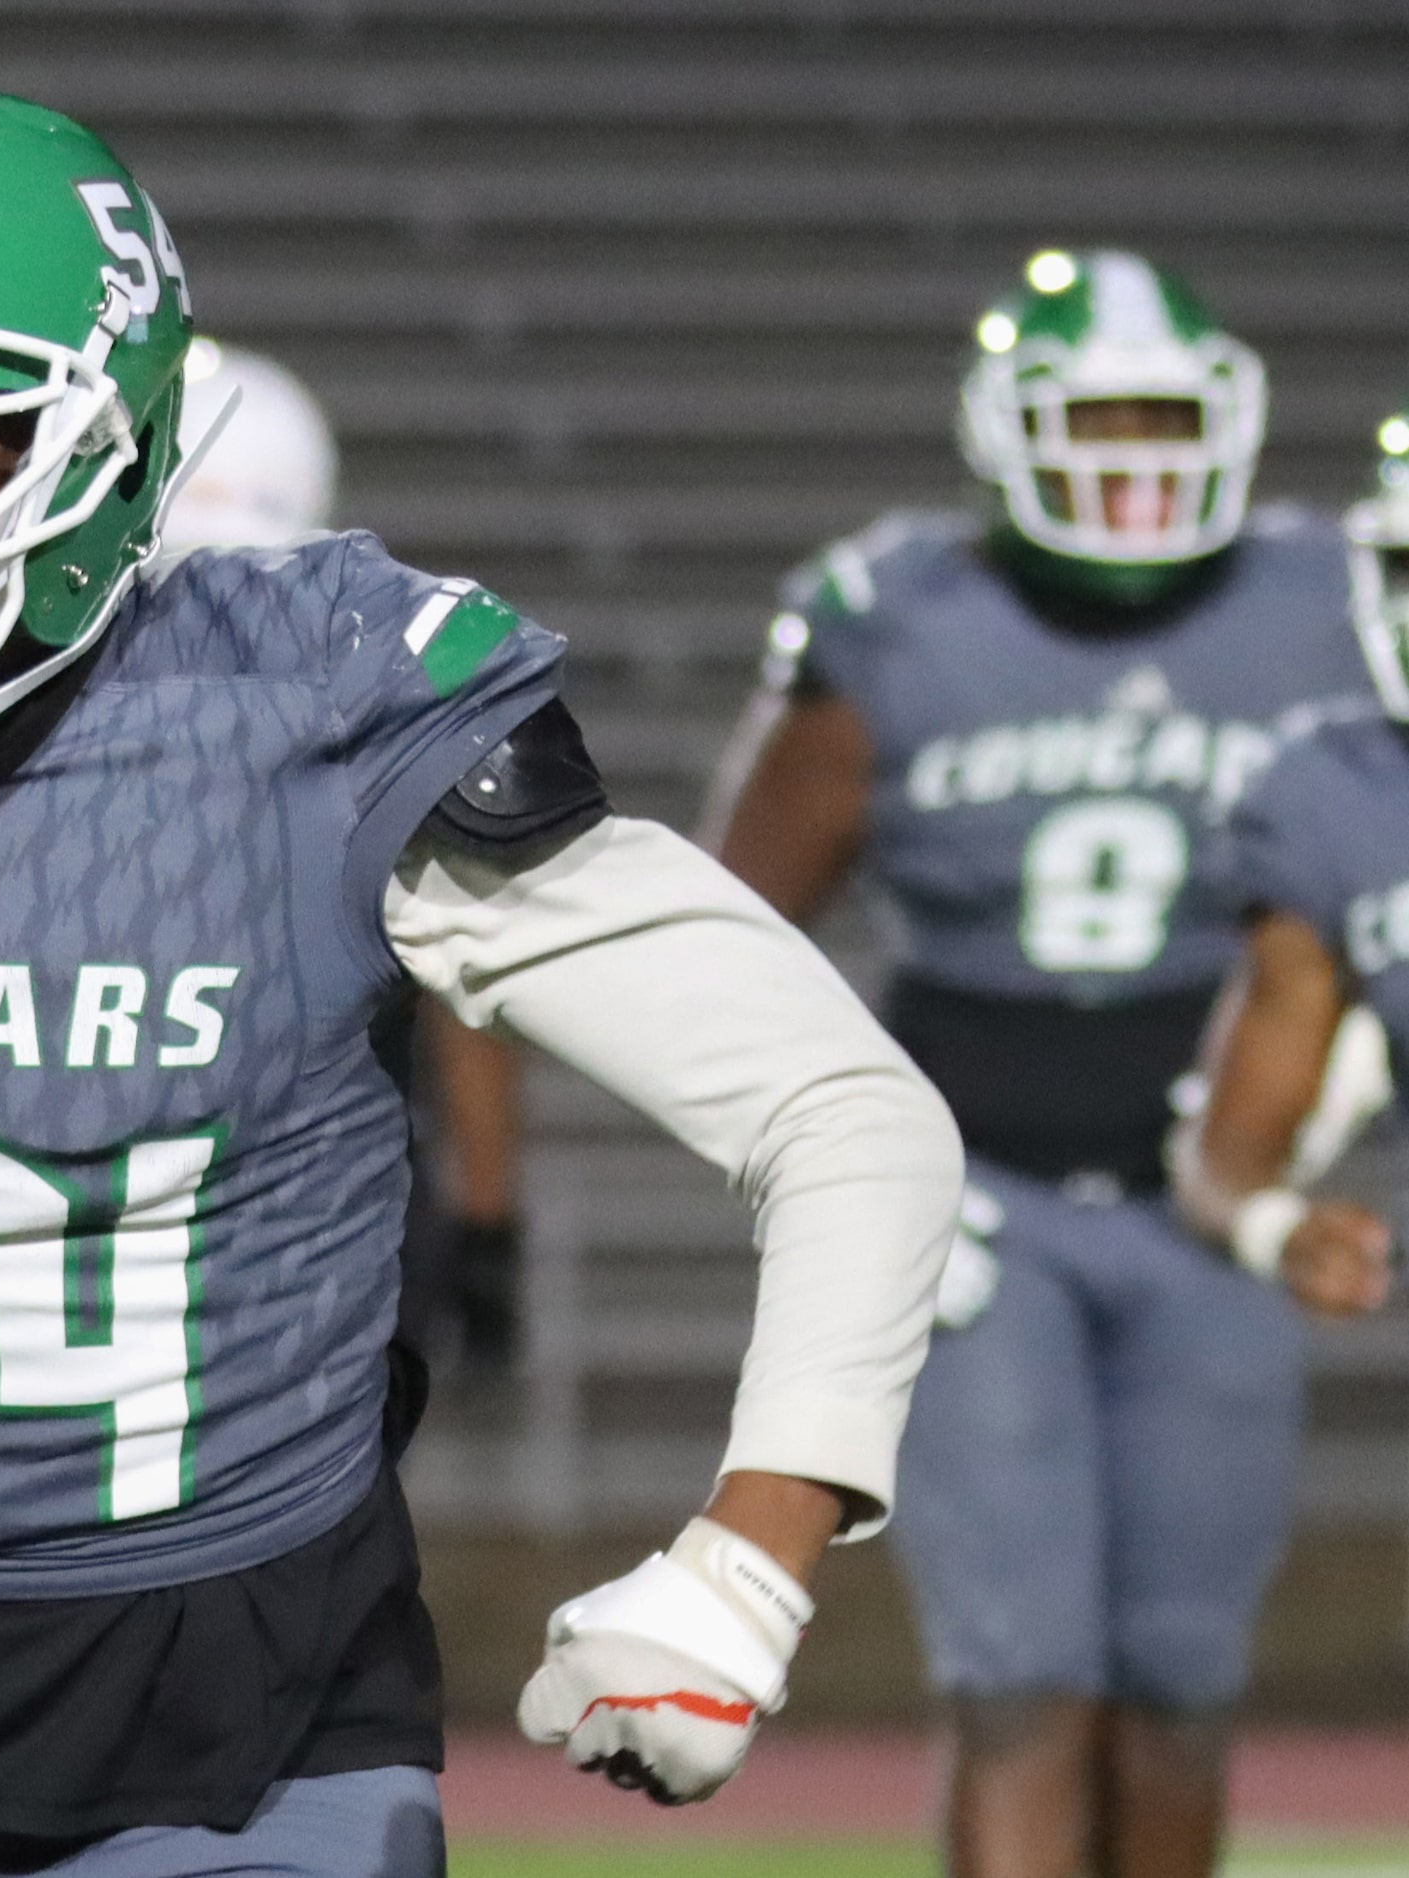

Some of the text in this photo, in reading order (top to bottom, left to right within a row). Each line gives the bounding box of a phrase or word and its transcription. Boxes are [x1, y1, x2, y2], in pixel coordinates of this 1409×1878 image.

[75, 178, 192, 322] 54
[905, 712, 1280, 825] COUGAR
[1019, 799, 1189, 972] 8
